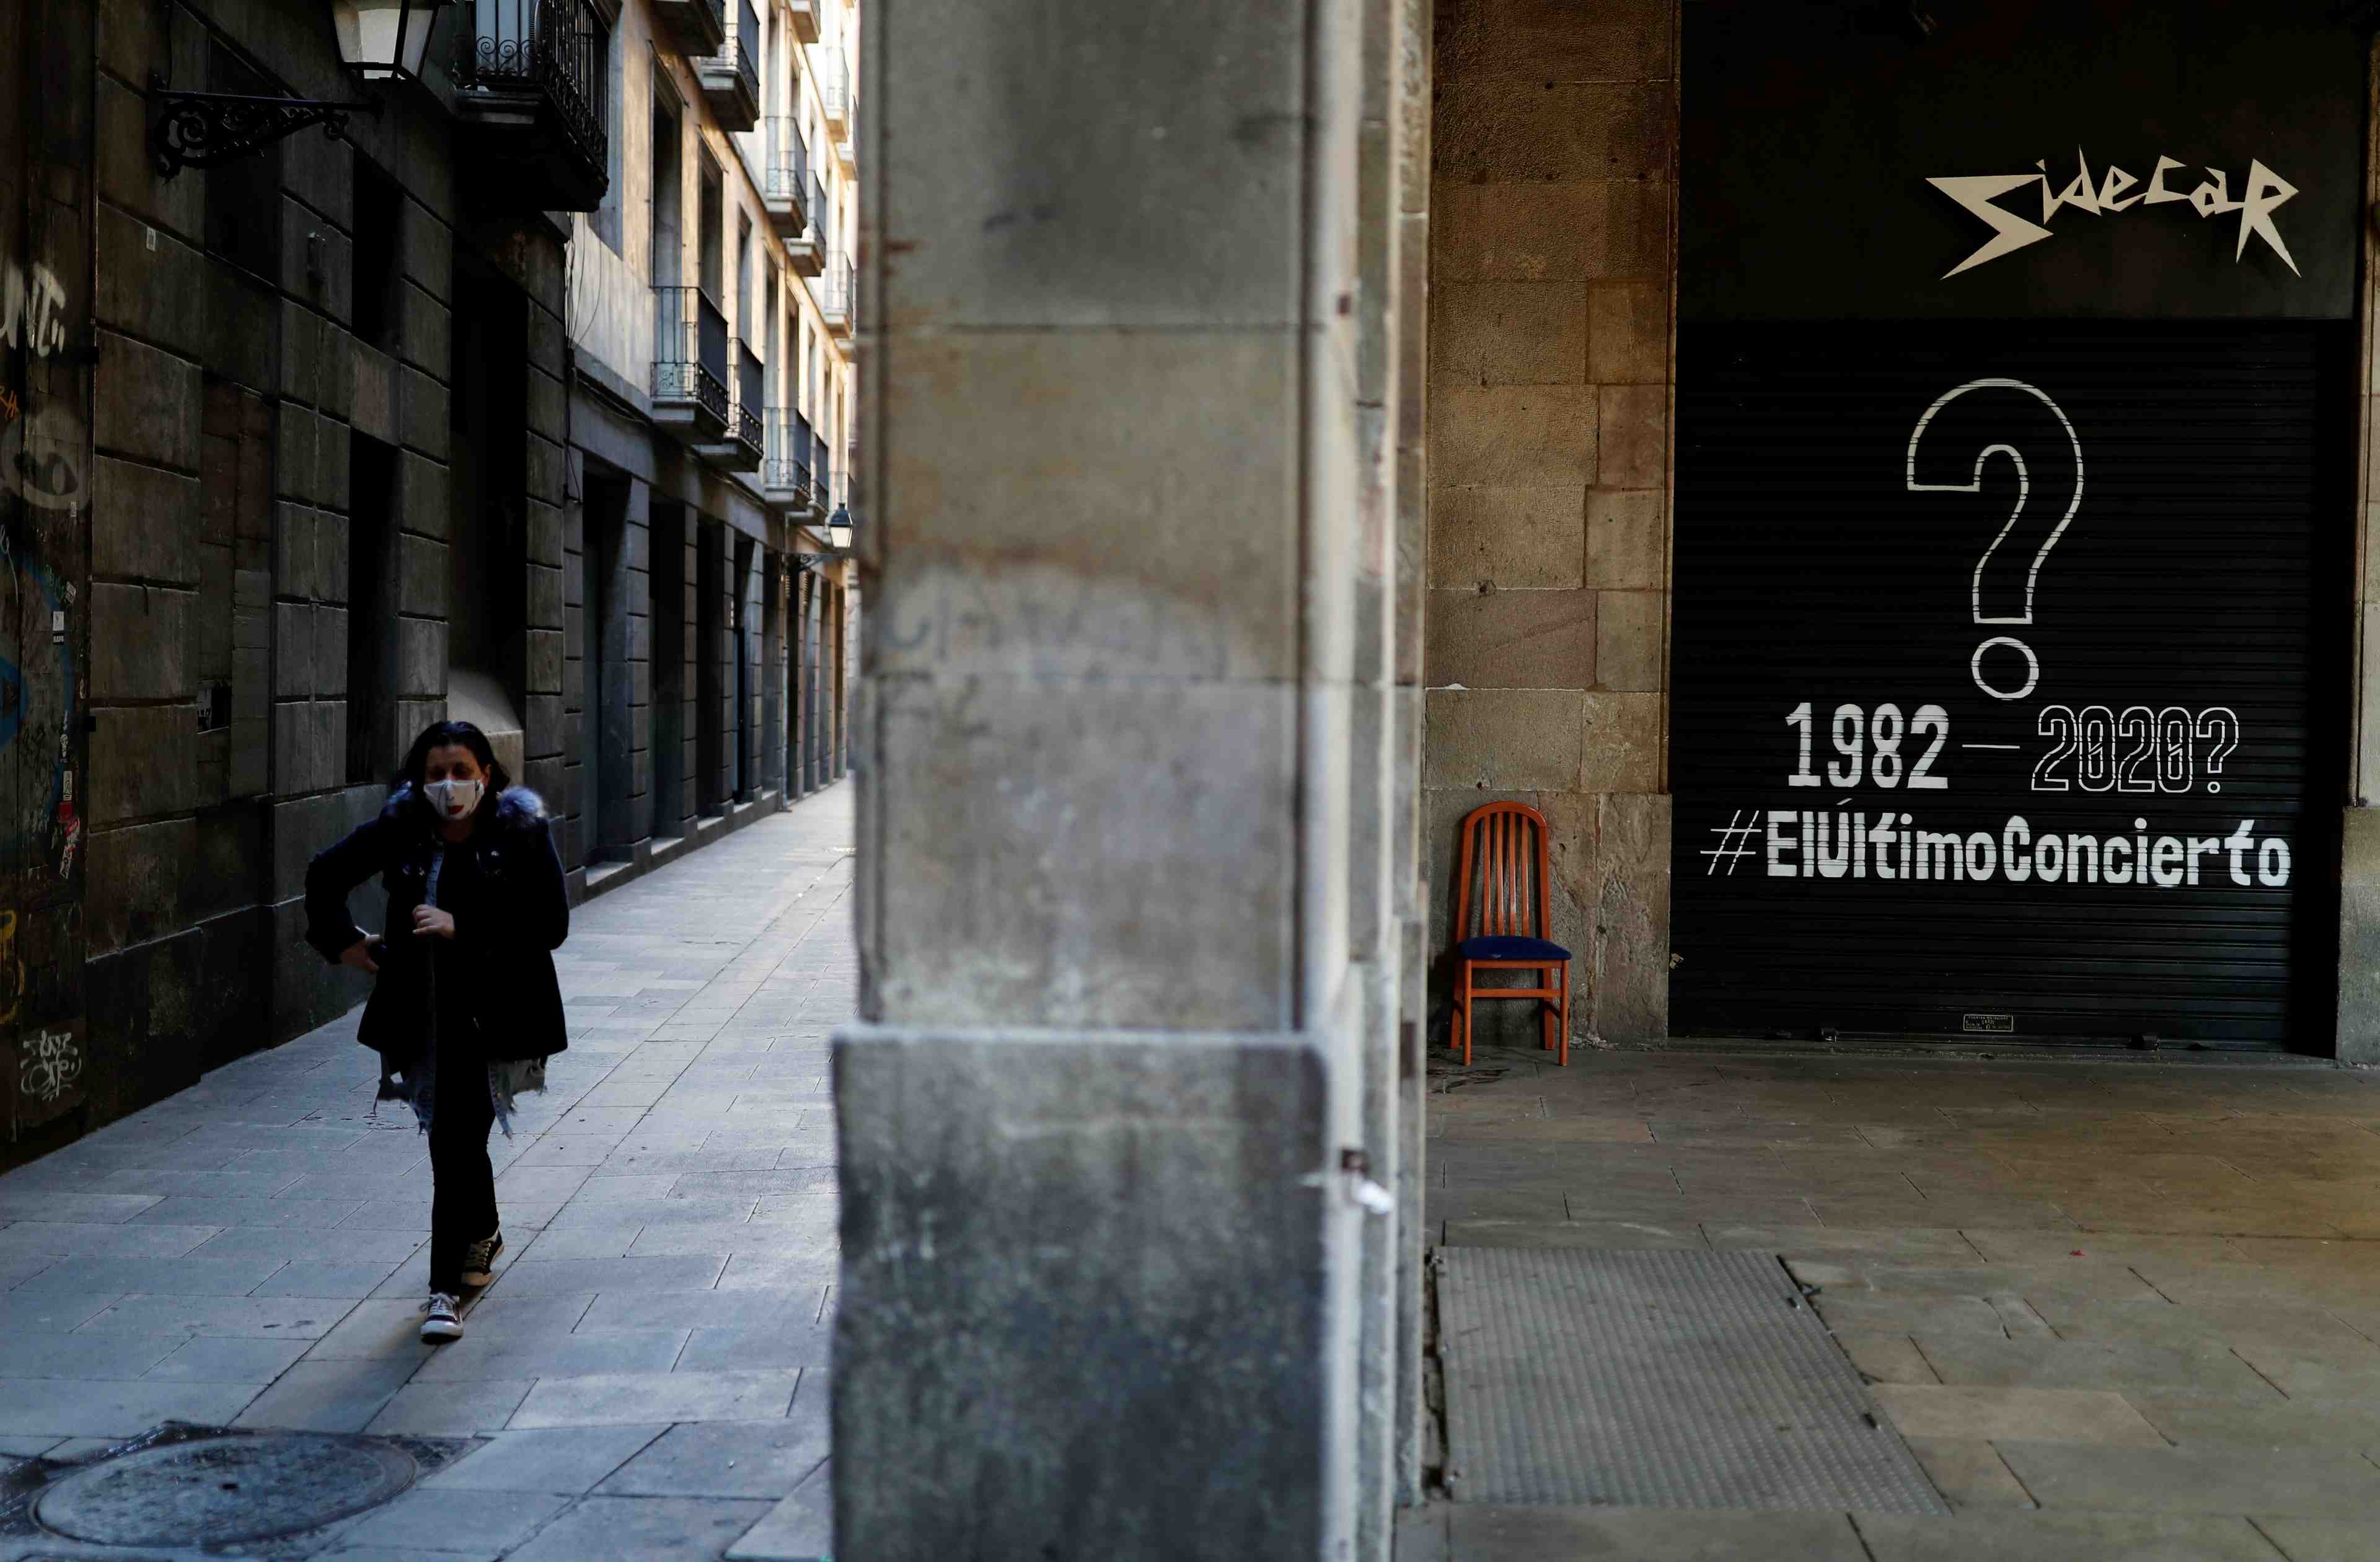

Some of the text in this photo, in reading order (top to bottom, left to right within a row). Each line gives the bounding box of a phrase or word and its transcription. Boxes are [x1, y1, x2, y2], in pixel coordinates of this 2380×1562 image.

[1786, 702, 1949, 789] 1982
[2032, 705, 2239, 793] 2020?
[1700, 798, 2291, 888] #ElÚltimoConcierto
